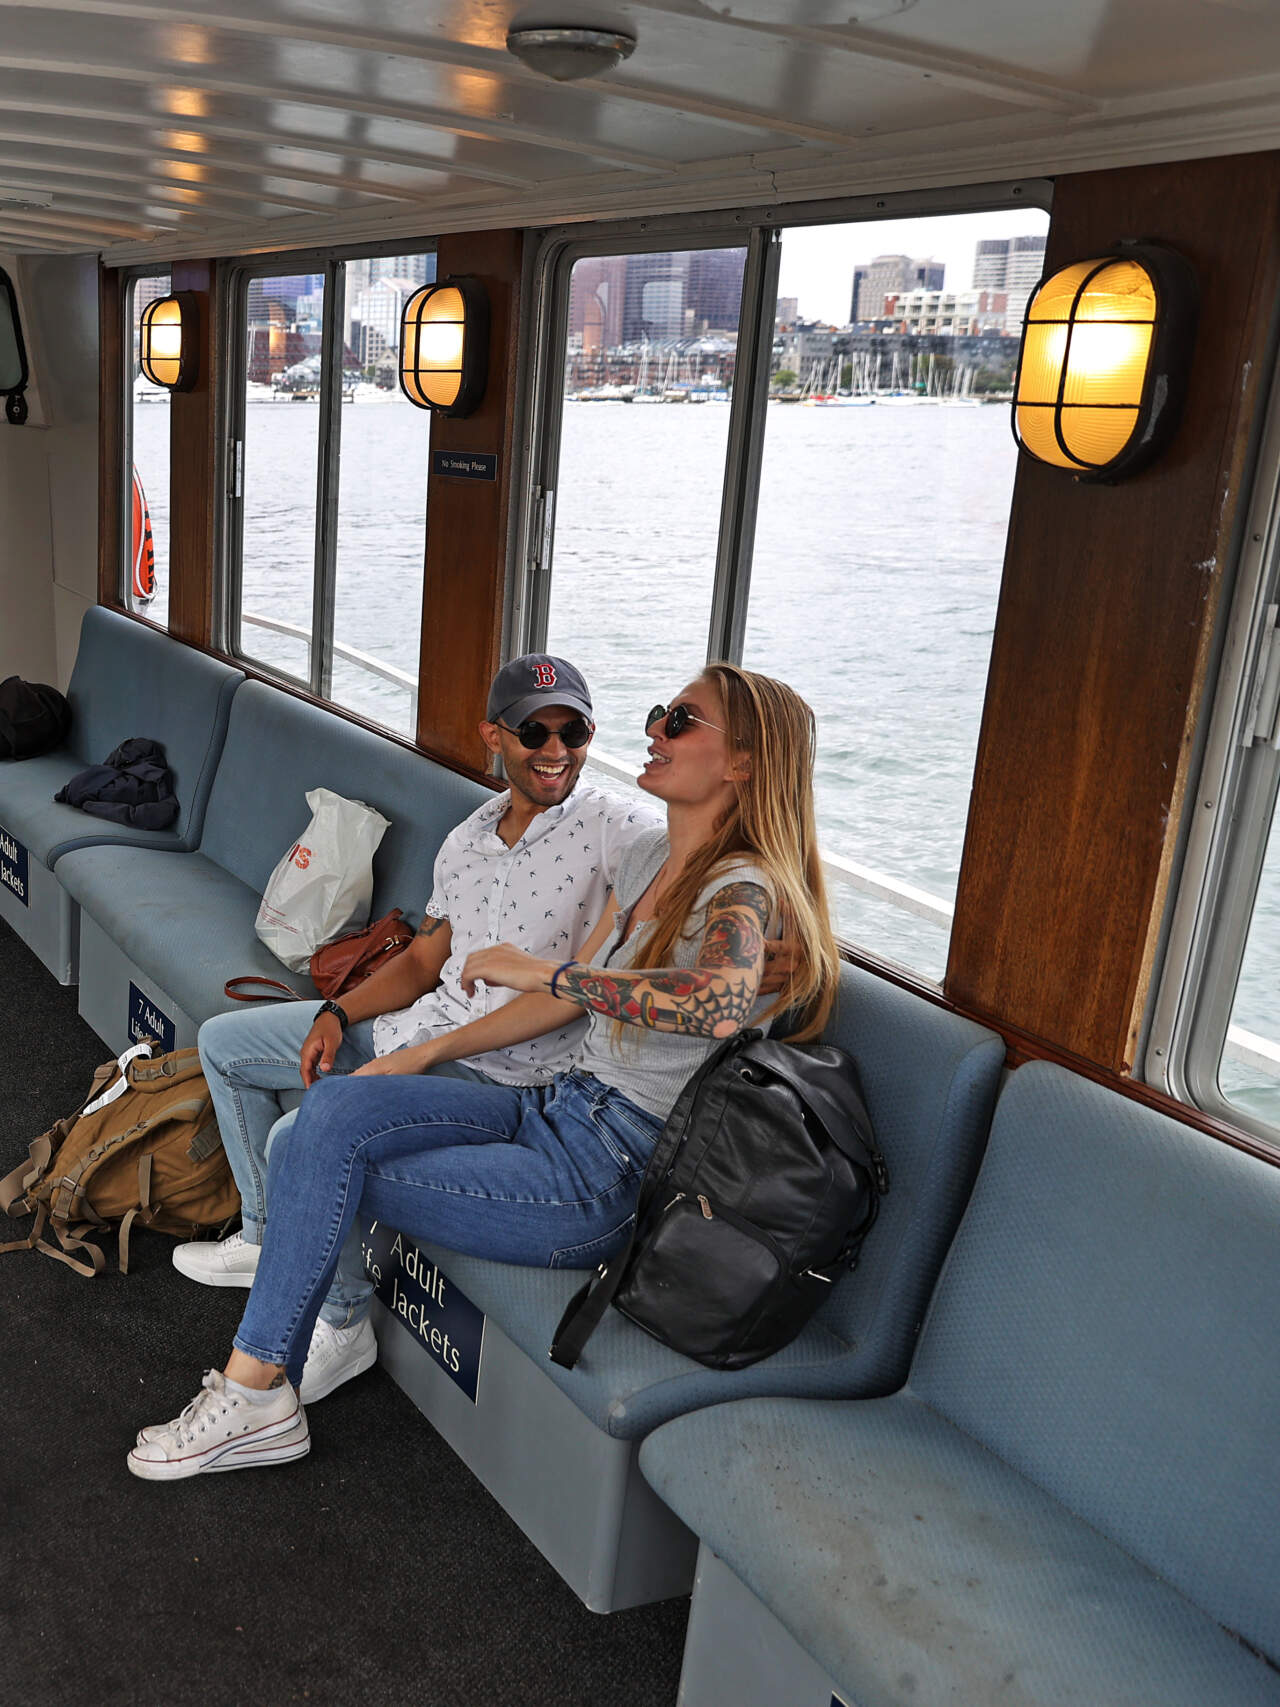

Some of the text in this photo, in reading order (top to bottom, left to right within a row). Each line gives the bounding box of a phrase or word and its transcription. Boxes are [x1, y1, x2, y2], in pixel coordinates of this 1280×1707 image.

[441, 459, 487, 472] No Smoking Please
[532, 664, 557, 688] B
[0, 833, 18, 864] Adult
[1, 860, 24, 897] Jackets
[138, 998, 165, 1039] 7 Adult
[390, 1232, 446, 1308] Adult
[361, 1242, 460, 1373] fe Jackets
